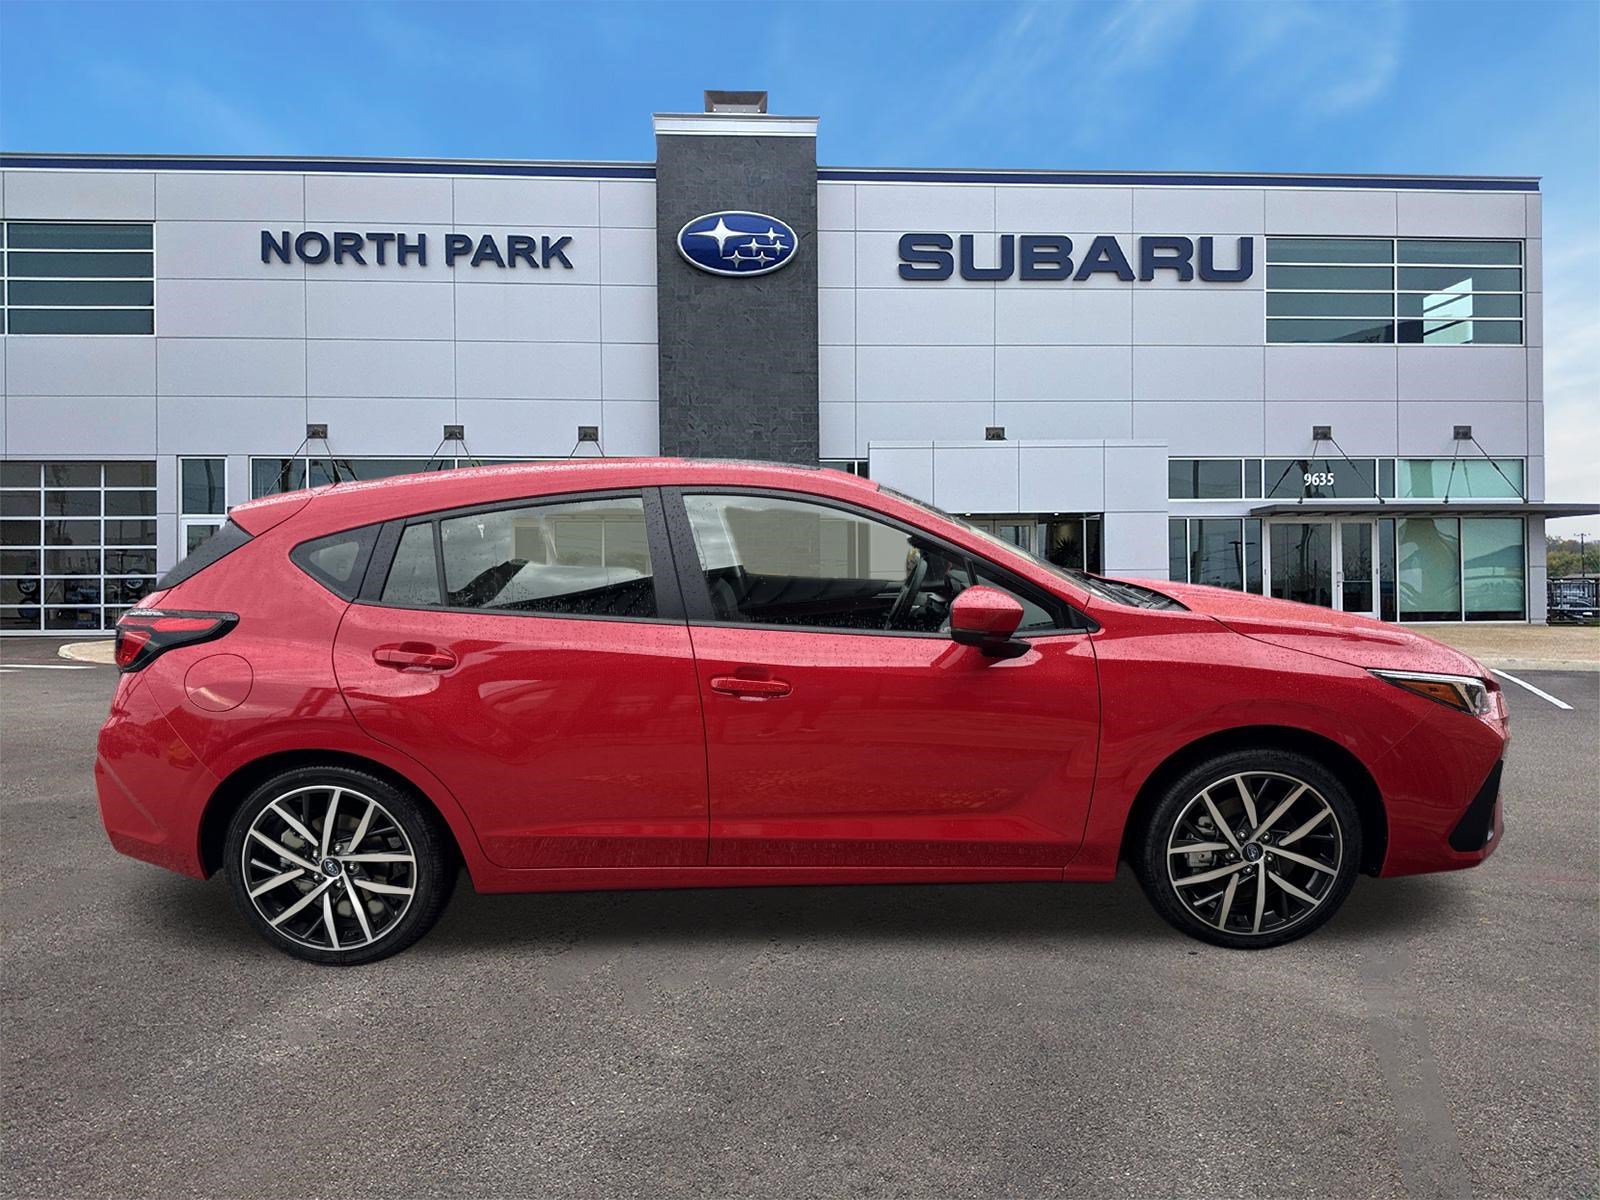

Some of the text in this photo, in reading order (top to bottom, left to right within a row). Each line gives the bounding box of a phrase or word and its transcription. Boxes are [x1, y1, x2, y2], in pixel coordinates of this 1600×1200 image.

[261, 231, 573, 269] NORTH PARK
[899, 233, 1254, 283] SUBARU
[1303, 472, 1335, 486] 9635
